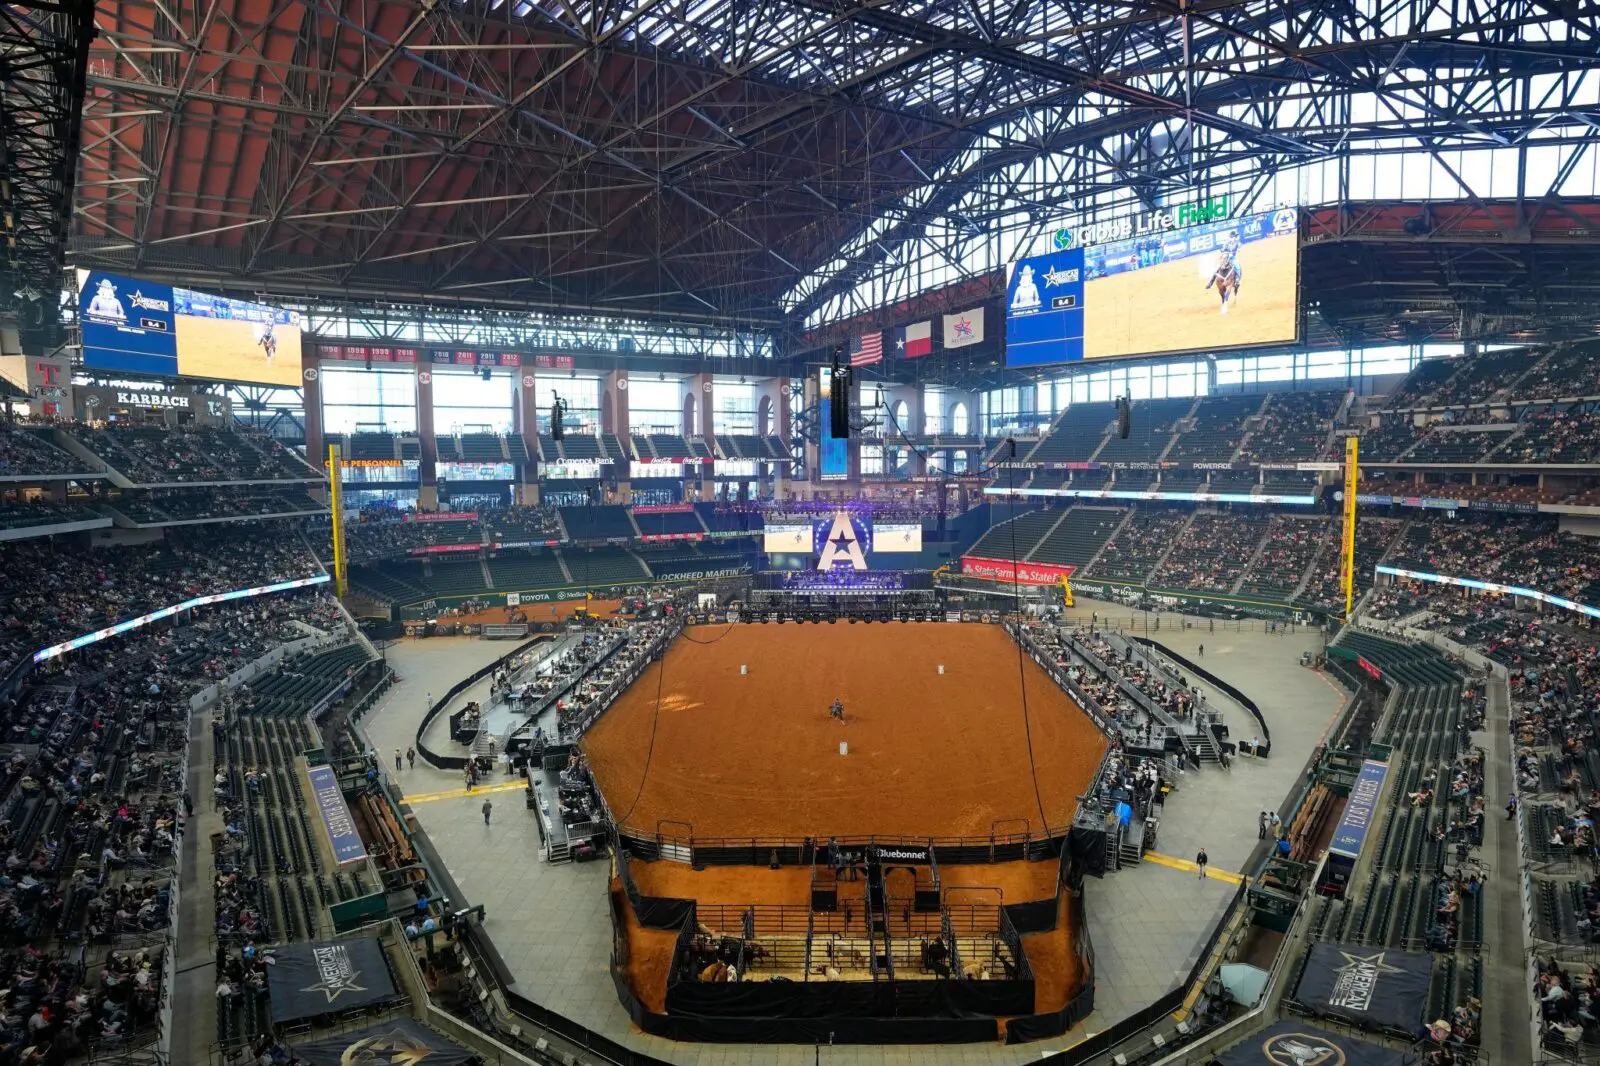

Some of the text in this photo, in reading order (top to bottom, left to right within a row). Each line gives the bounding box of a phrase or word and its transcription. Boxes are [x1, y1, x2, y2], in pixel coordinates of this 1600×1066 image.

[1136, 210, 1173, 233] Life
[1178, 195, 1227, 224] Field
[117, 392, 189, 407] KARBACH
[351, 459, 401, 467] PERSONNEL
[595, 457, 615, 465] Bank
[1193, 462, 1232, 470] POWERADE
[656, 569, 739, 582] LOCKHEED MARTIN
[1075, 583, 1104, 592] National
[521, 594, 550, 602] TOYOTA
[1243, 605, 1285, 617] HeGetsUs.com
[318, 786, 341, 807] TEXAS
[1352, 778, 1379, 806] RANGERS
[324, 806, 352, 838] RANGERS
[1343, 806, 1369, 829] TEXAS
[880, 848, 926, 860] Bluebonnet
[317, 946, 344, 988] AMERICAN
[1346, 961, 1377, 1011] AMERICAN
